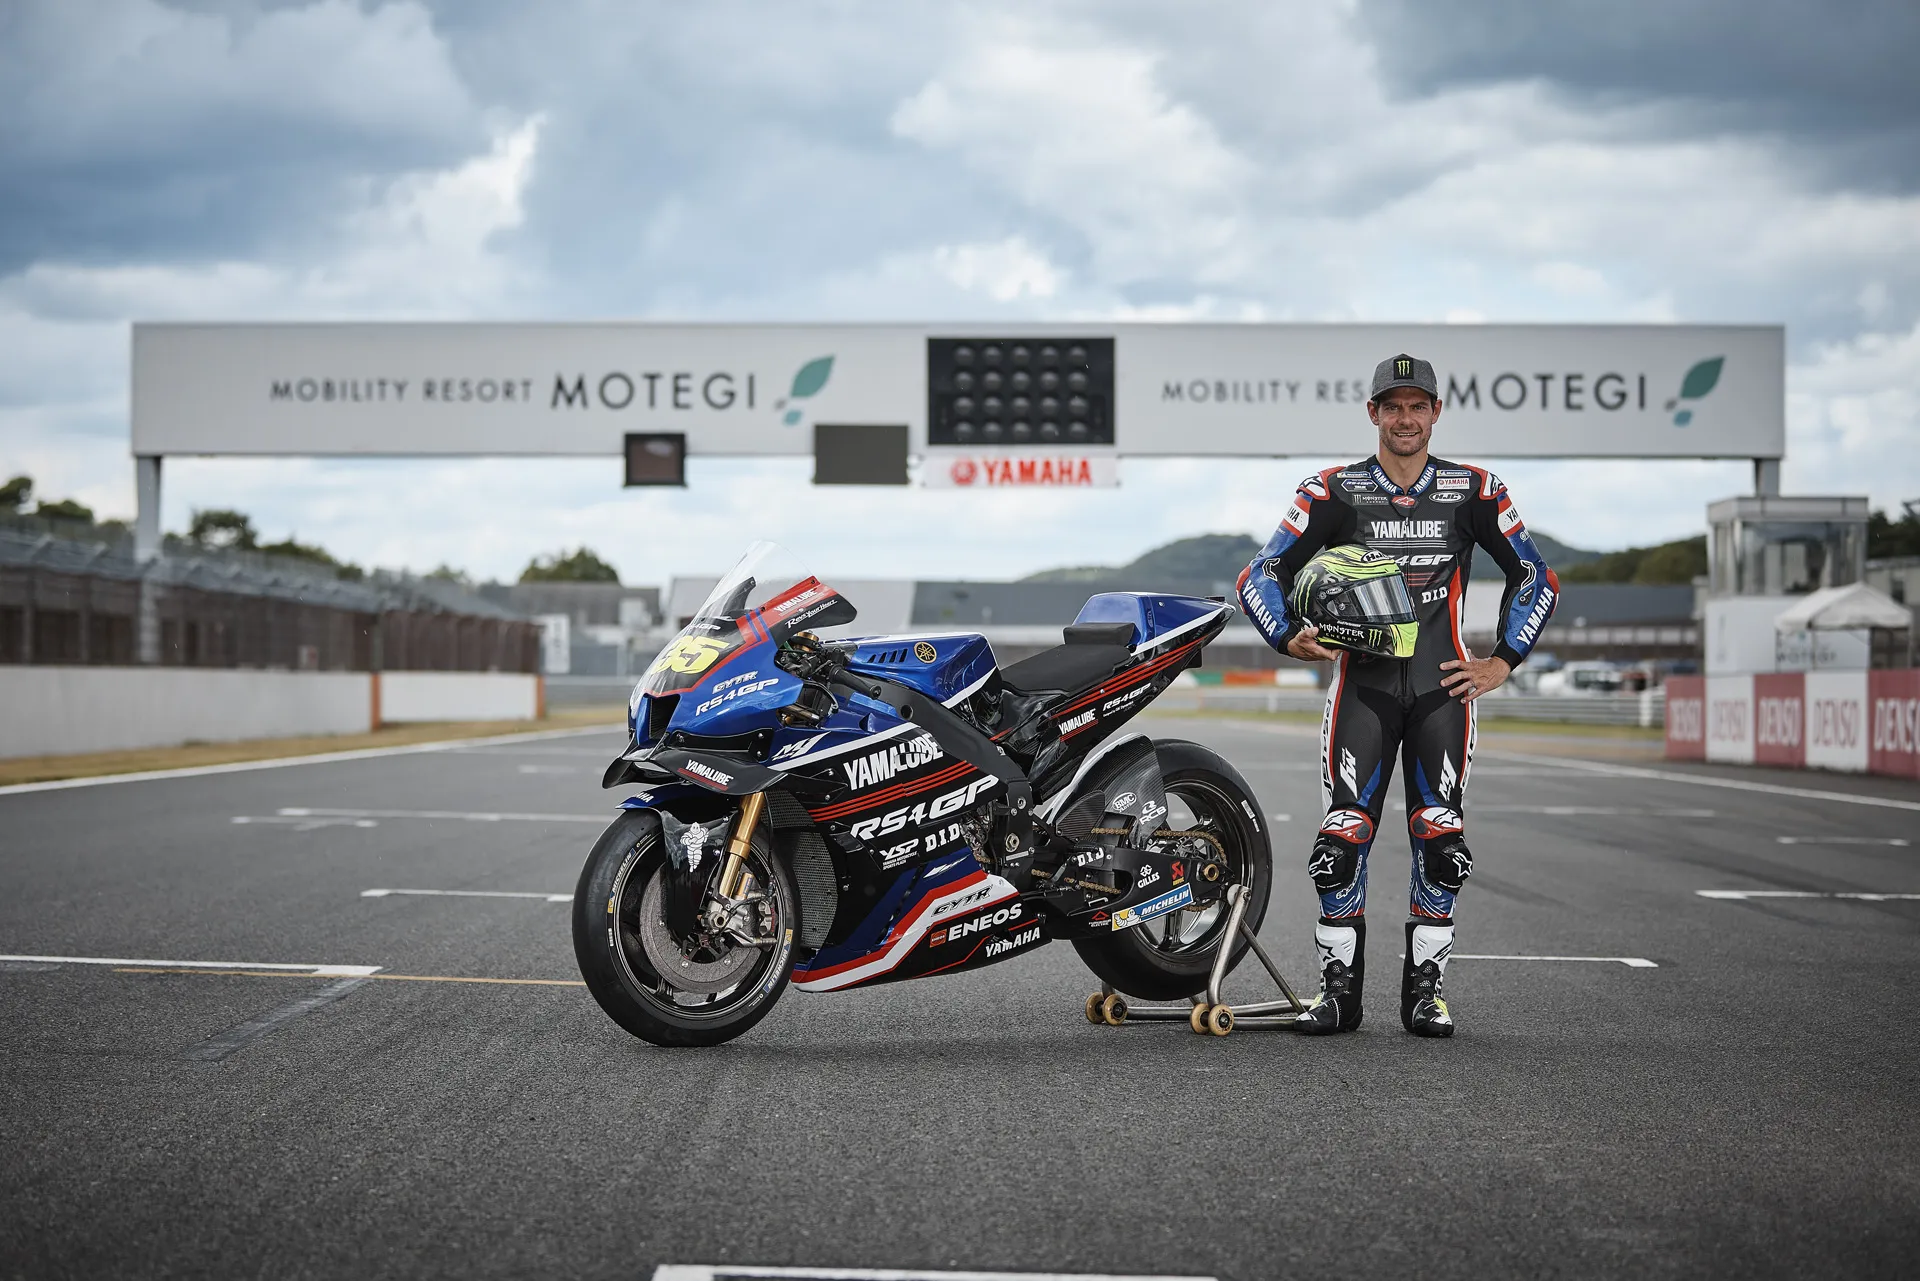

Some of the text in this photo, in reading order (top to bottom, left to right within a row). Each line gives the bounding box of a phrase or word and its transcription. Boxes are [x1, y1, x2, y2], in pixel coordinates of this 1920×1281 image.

[269, 372, 757, 411] MOBILITY RESORT MOTEGI
[1162, 373, 1647, 412] MOBILITY RES MOTEGI
[982, 459, 1092, 487] YAMAHA
[1373, 467, 1398, 494] YAMAHA
[1413, 466, 1435, 493] YAMAHA
[1370, 520, 1443, 539] YAMALUBE
[1396, 554, 1455, 566] 4GP
[774, 588, 818, 613] YAMALUBE
[1242, 580, 1278, 637] YAMAHA
[1319, 622, 1365, 639] MONSTER
[1516, 586, 1555, 646] YAMAHA
[712, 670, 759, 694] GYTR
[695, 678, 779, 717] RS4GP
[1102, 682, 1152, 712] RS4GP
[1058, 708, 1097, 735] YAMALUBE
[1669, 699, 1701, 741] DENSO
[1711, 700, 1746, 742] DENSO
[1758, 699, 1801, 746] DENSO
[1813, 699, 1861, 746] DENSO
[685, 759, 734, 787] YAMALUBE
[843, 733, 944, 791] YAMALUBE
[850, 774, 999, 840] RS4GP
[1115, 794, 1135, 810] BMC
[1139, 806, 1167, 825] RCB
[879, 838, 919, 861] YSP
[1137, 871, 1160, 889] GILLES
[930, 884, 993, 918] GYTR
[1141, 890, 1190, 915] MICHELIN
[948, 903, 1023, 942] ENEOS
[985, 927, 1041, 958] YAMAHA
